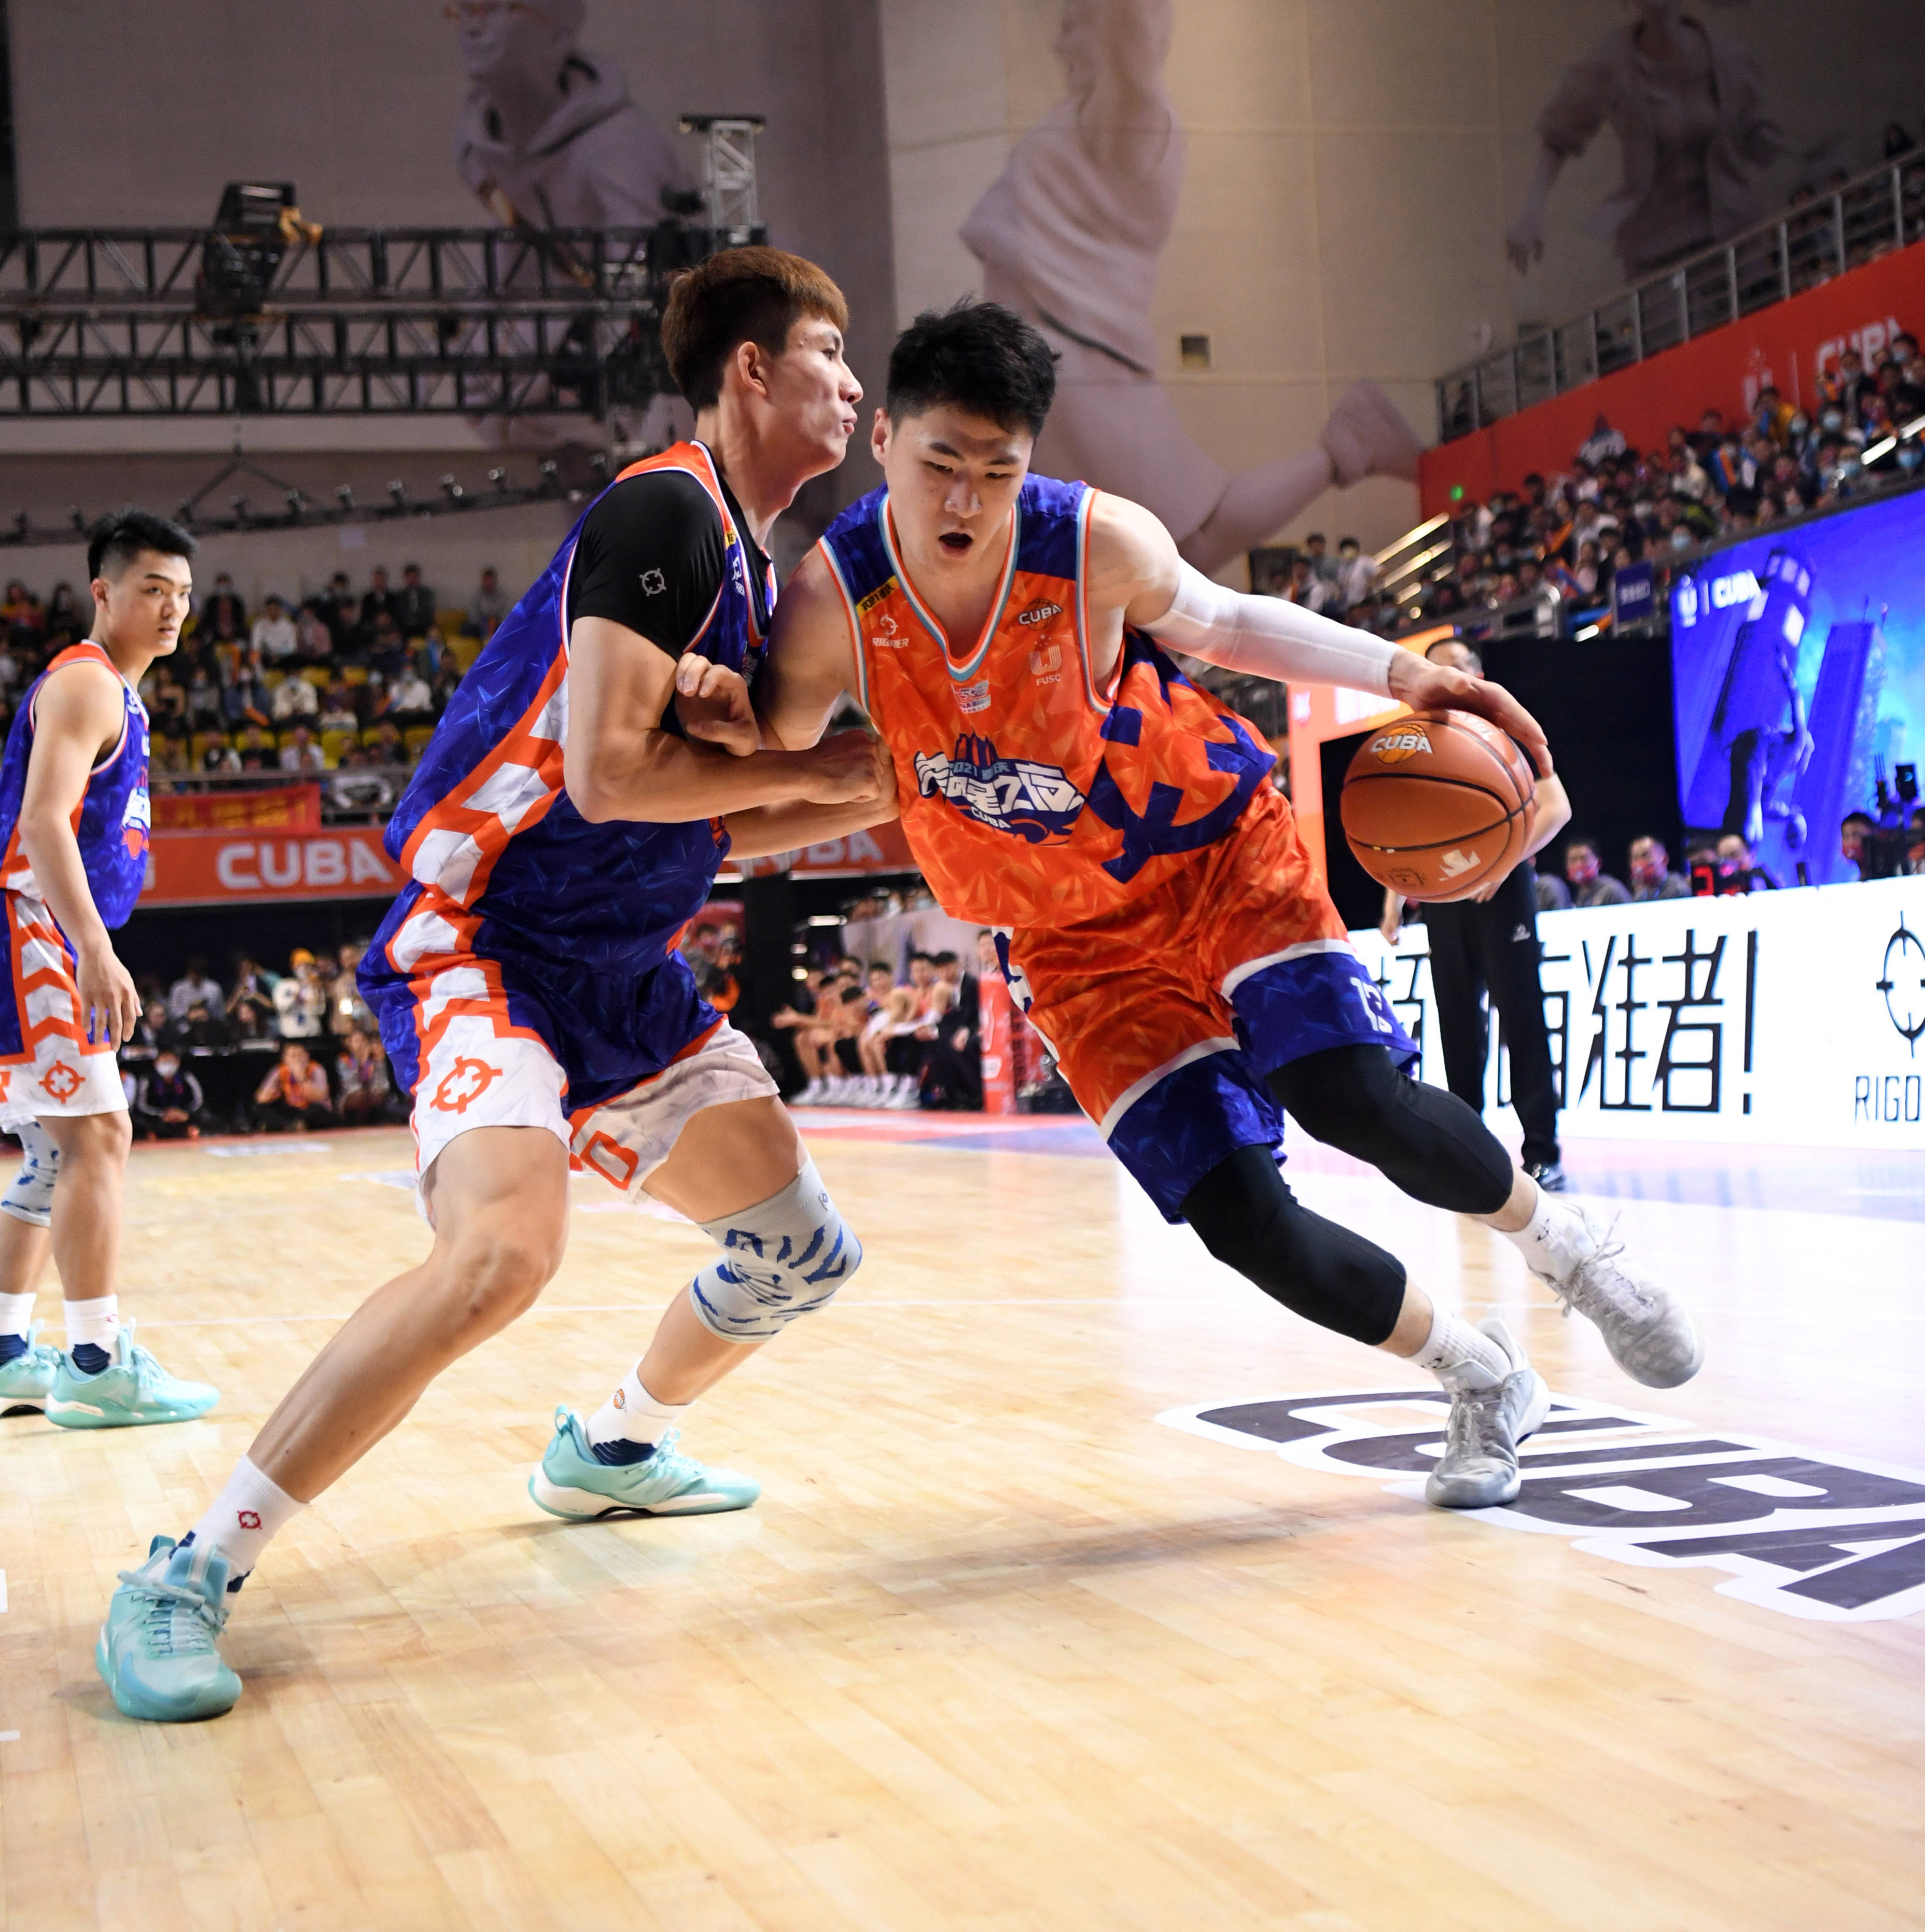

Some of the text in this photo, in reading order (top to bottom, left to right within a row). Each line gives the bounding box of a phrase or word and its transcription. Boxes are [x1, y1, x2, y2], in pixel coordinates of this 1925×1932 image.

[1019, 604, 1063, 625] CUBA
[1036, 674, 1061, 686] FUSC
[1371, 735, 1433, 753] CUBA
[971, 805, 1012, 829] CUBA
[216, 837, 394, 891] CUBA
